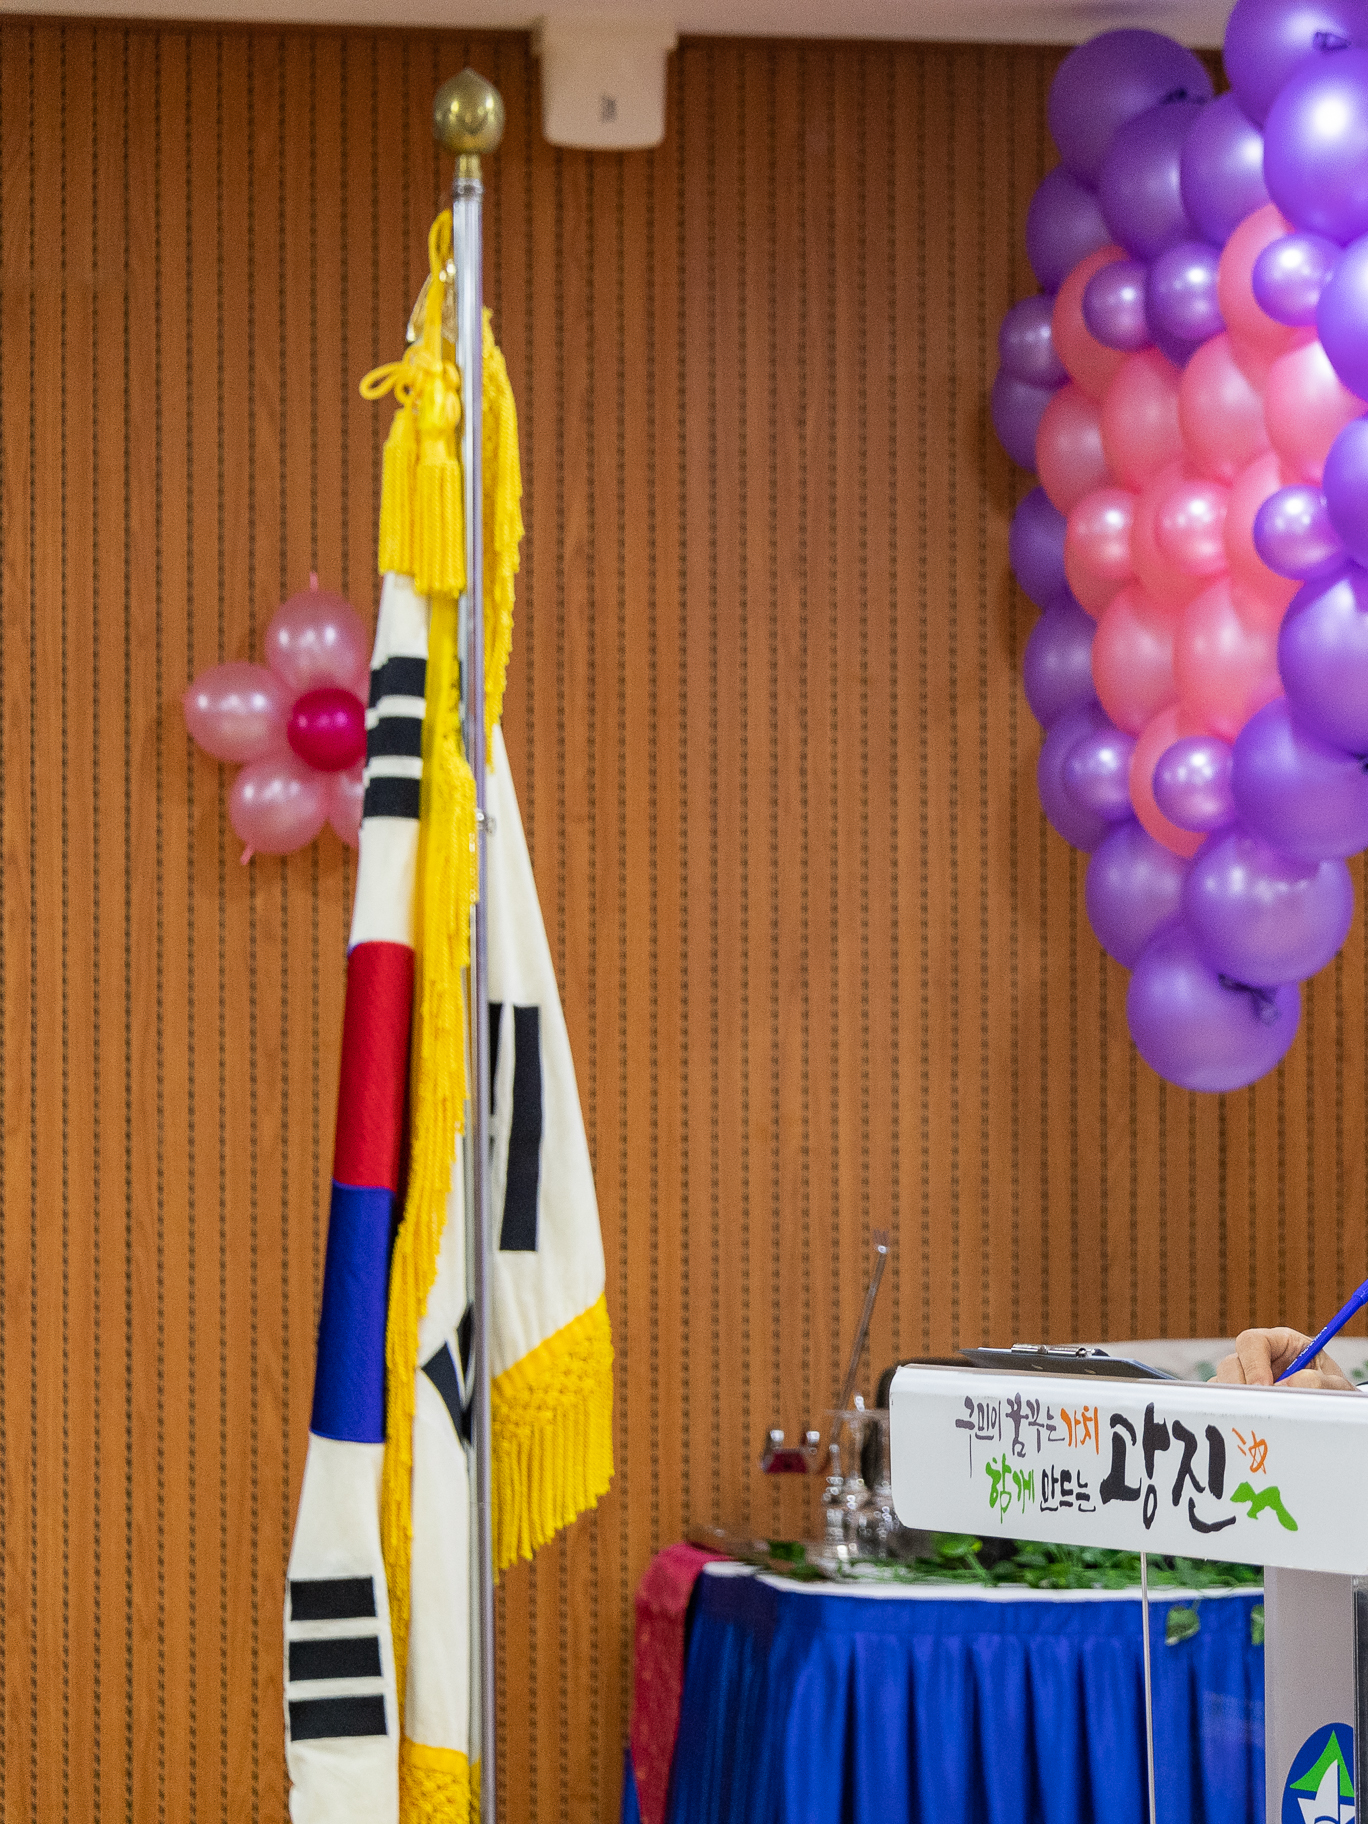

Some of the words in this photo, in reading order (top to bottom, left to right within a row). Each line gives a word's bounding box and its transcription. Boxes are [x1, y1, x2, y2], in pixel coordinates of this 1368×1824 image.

[955, 1395, 1002, 1479] 구민이
[1005, 1392, 1066, 1458] 꿈꾸는
[1060, 1405, 1100, 1456] 가치
[1099, 1401, 1237, 1534] 광진
[985, 1453, 1035, 1525] 함께
[1039, 1464, 1097, 1513] 만드는
